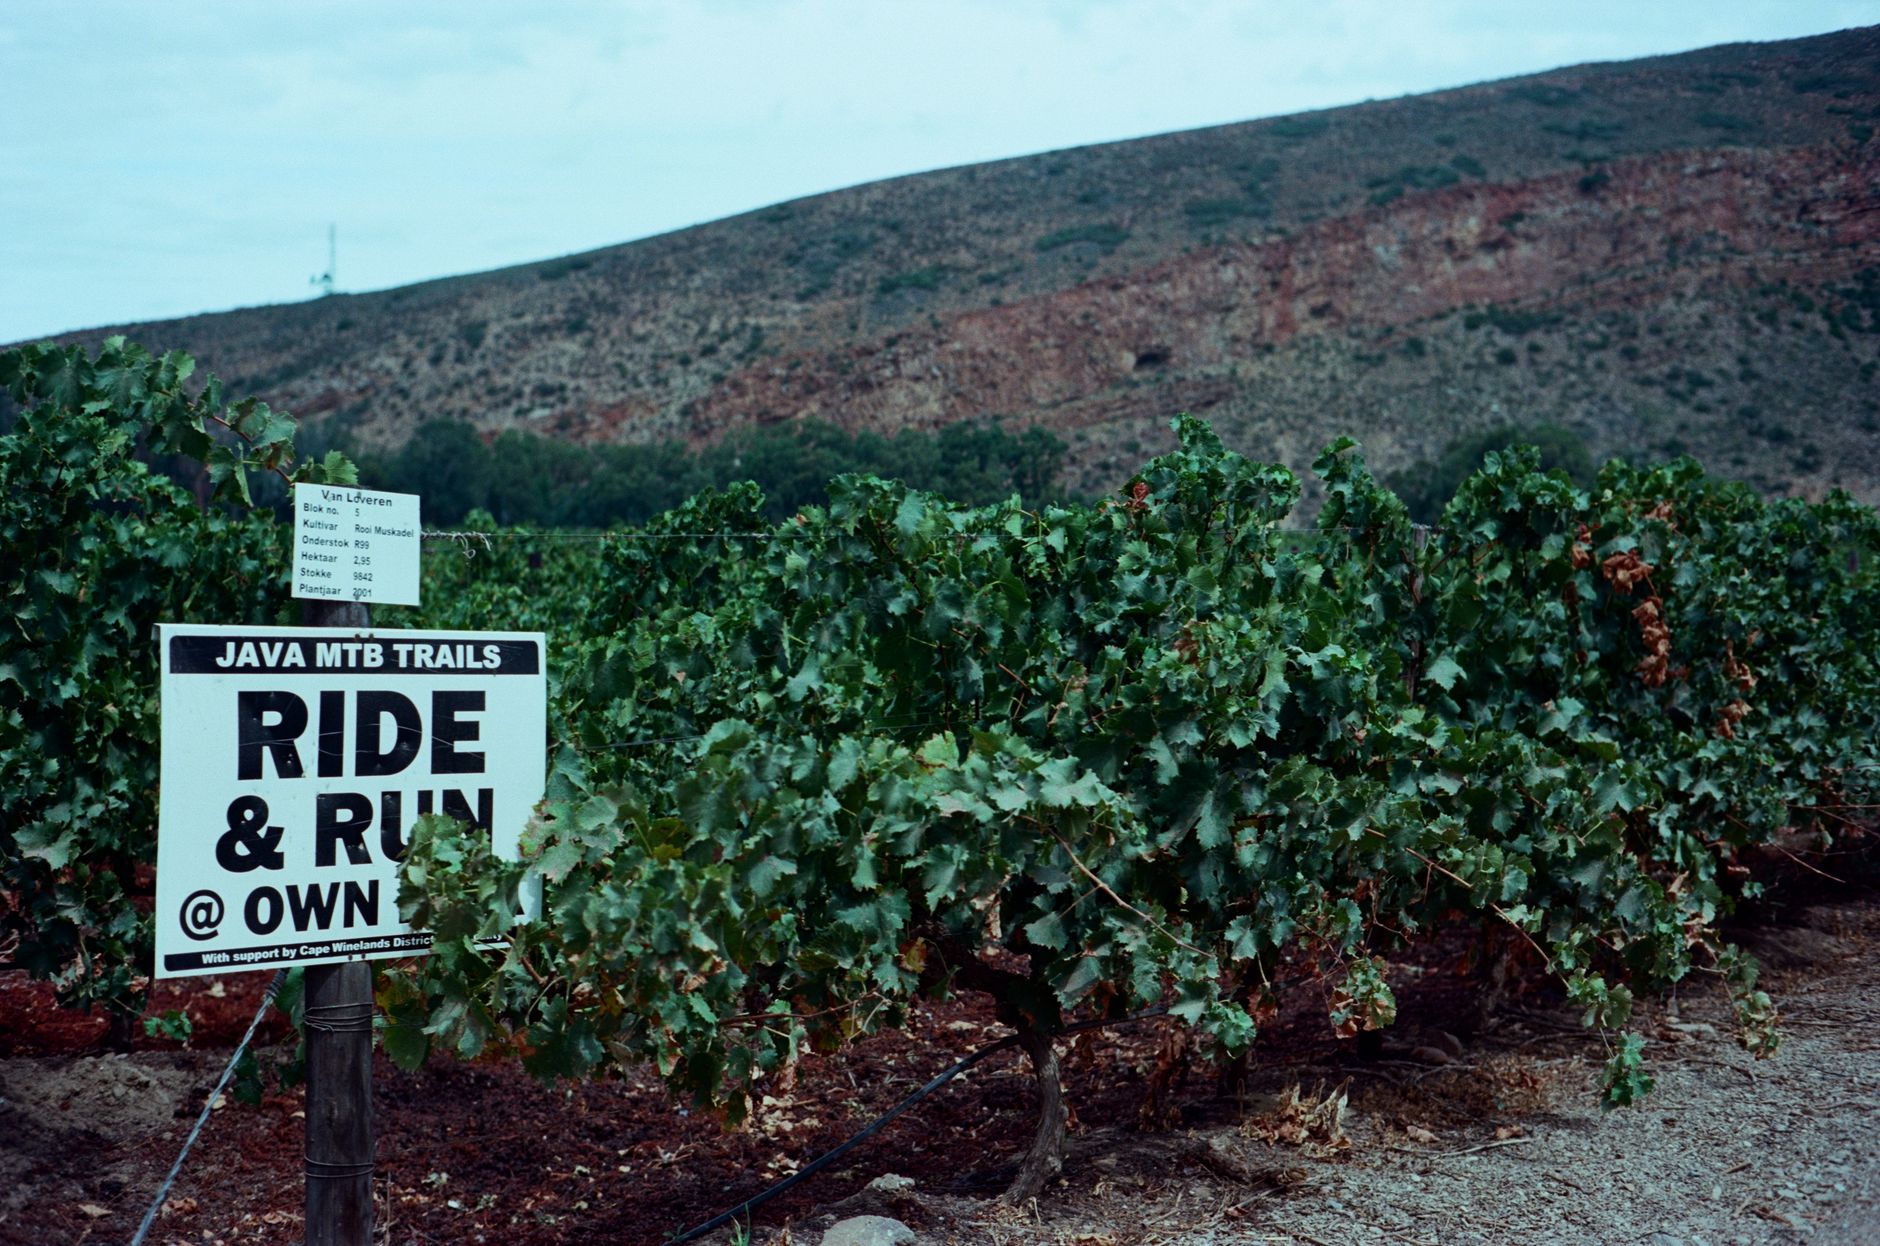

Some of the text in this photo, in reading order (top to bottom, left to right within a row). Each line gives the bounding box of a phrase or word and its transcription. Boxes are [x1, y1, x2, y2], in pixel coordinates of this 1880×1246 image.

[321, 489, 393, 507] Van Loveren
[303, 502, 360, 517] Blok no. 5
[303, 519, 414, 538] Kultivar Rooi Muskadel
[302, 535, 369, 550] Onderstok R99
[301, 551, 338, 563] Hektaar
[300, 567, 332, 579] Stokke
[299, 583, 372, 597] Plantjaar 2001
[215, 641, 501, 669] JAVA MTB TRAILS
[237, 690, 486, 780] RIDE
[215, 795, 285, 873] &
[179, 889, 225, 942] @
[243, 879, 380, 936] OWN
[201, 952, 231, 965] With
[232, 949, 280, 964] support
[282, 947, 298, 960] by
[299, 944, 331, 958] Cape
[332, 939, 391, 953] Winelands
